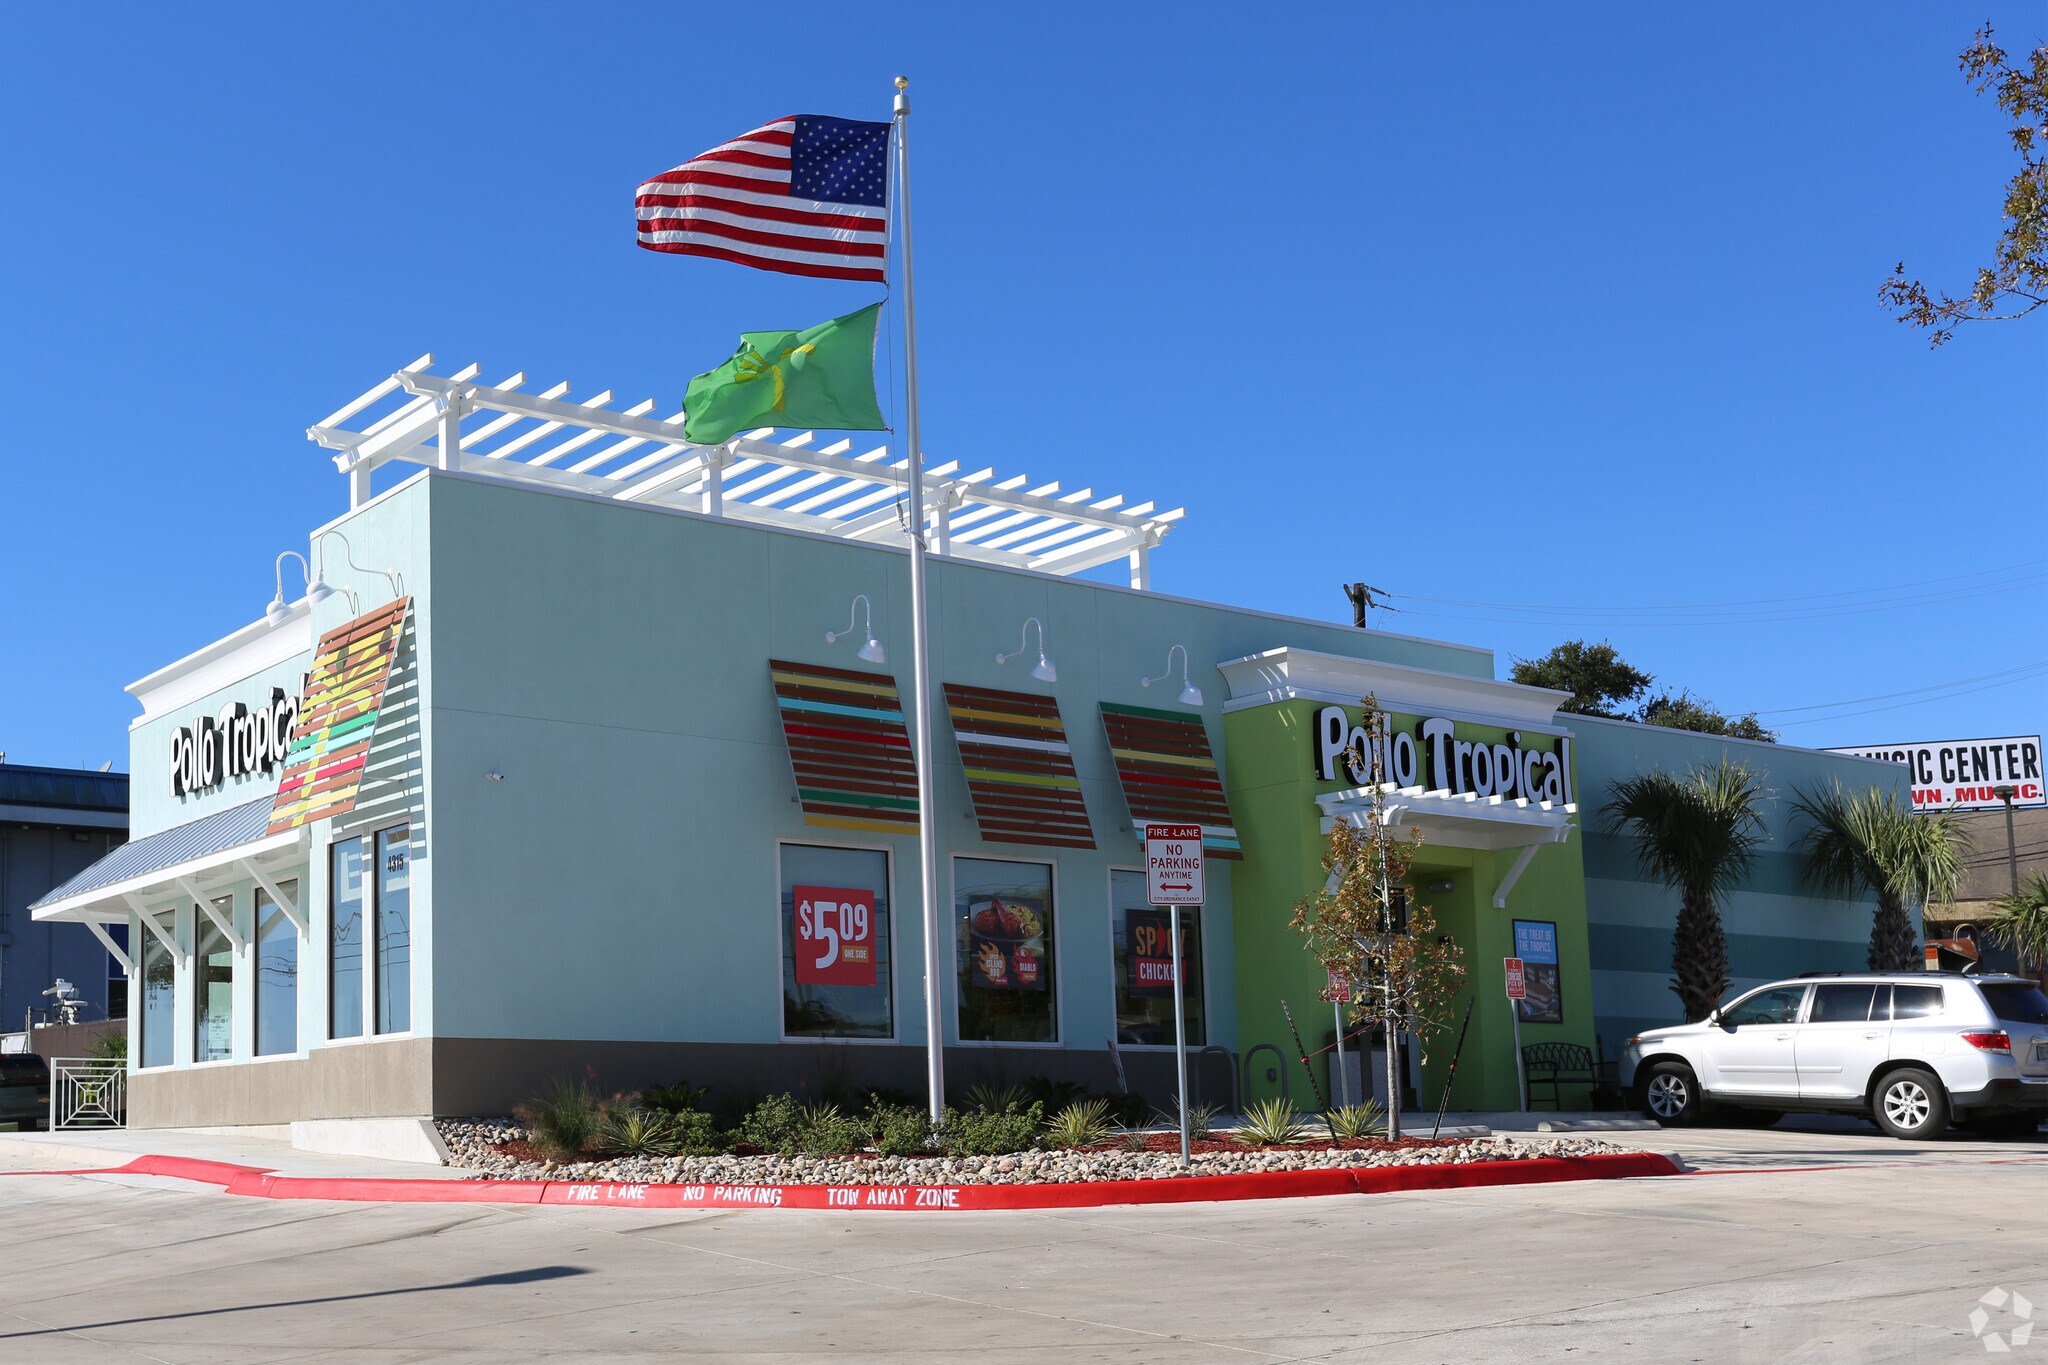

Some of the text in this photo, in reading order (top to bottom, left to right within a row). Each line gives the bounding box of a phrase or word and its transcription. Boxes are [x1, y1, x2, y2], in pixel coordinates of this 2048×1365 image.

[169, 715, 223, 797] Pollo
[1416, 717, 1574, 806] Tropical
[1939, 743, 2039, 784] CENTER
[1955, 784, 2043, 802] MUIC.
[1148, 828, 1199, 837] FIRE LANE
[1166, 844, 1183, 856] NO
[387, 853, 404, 873] 4315
[1150, 858, 1200, 870] PARKING
[1159, 871, 1193, 880] ANYTIME
[1518, 928, 1552, 941] THE TREAT OF
[1519, 940, 1553, 953] THE TROPICS.
[844, 949, 867, 959] ONE SIDE
[1020, 963, 1037, 972] DIABLO
[1140, 963, 1175, 980] CHICKE
[567, 1184, 960, 1207] FIRE LANE NO PARKING TOW AWAY ZONE
